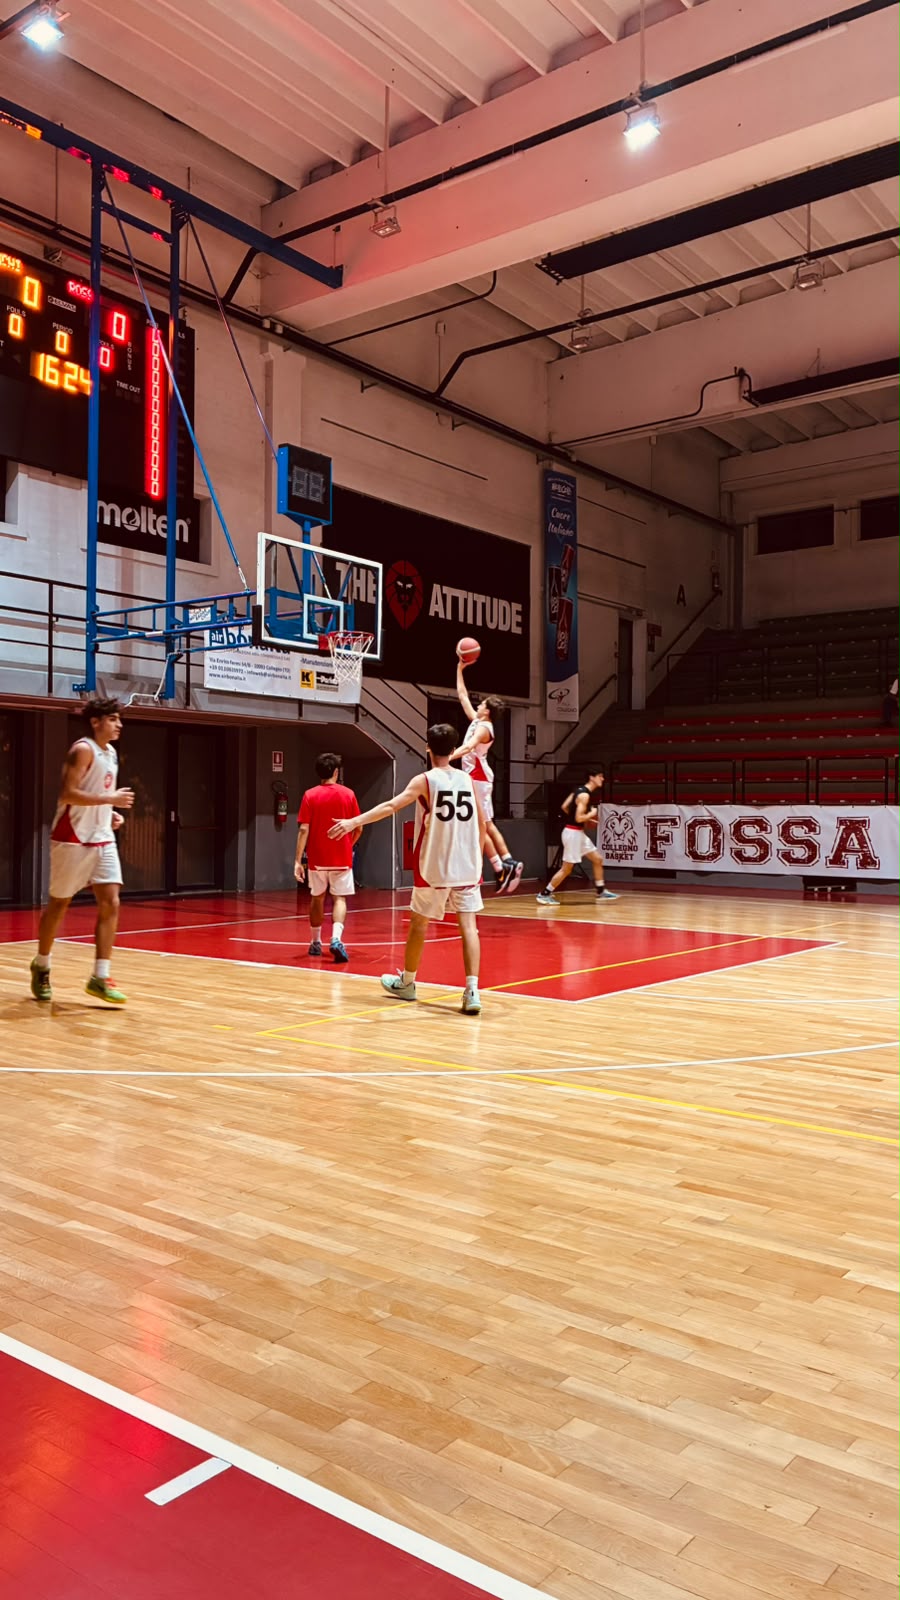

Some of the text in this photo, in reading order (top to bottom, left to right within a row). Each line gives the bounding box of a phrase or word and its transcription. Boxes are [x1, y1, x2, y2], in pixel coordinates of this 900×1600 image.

[6, 305, 26, 317] FOULS
[52, 322, 74, 335] PERIOD
[116, 380, 140, 393] TIME OUT
[96, 500, 189, 543] molten
[335, 562, 522, 635] THE ATTITUDE
[435, 790, 473, 822] 55
[601, 843, 639, 852] COLLEGNO
[644, 815, 880, 870] FOSSA
[605, 852, 634, 861] BASKET
